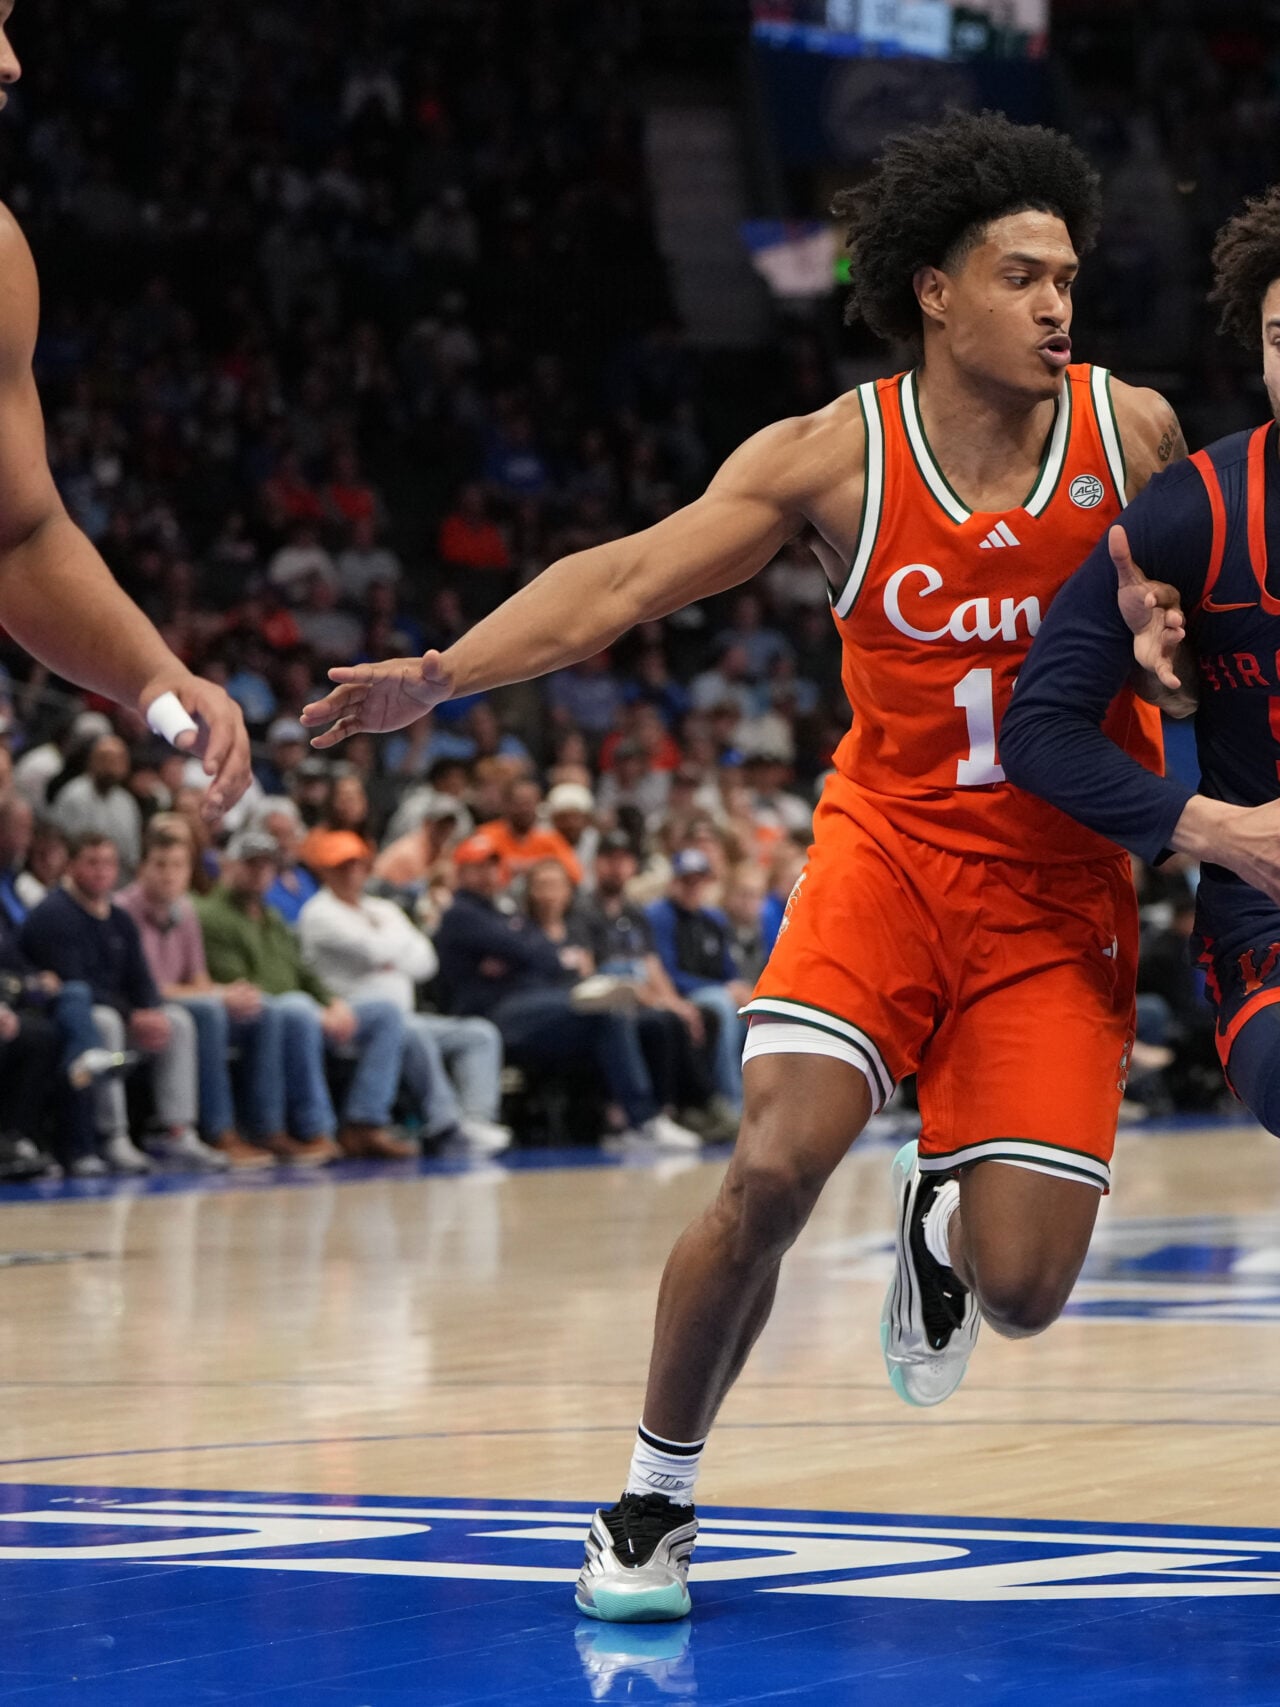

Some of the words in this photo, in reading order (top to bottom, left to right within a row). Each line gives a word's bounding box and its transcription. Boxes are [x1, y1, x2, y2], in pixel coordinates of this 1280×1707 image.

[1073, 483, 1100, 496] ACC
[883, 564, 1041, 643] Can
[953, 668, 1016, 786] 1
